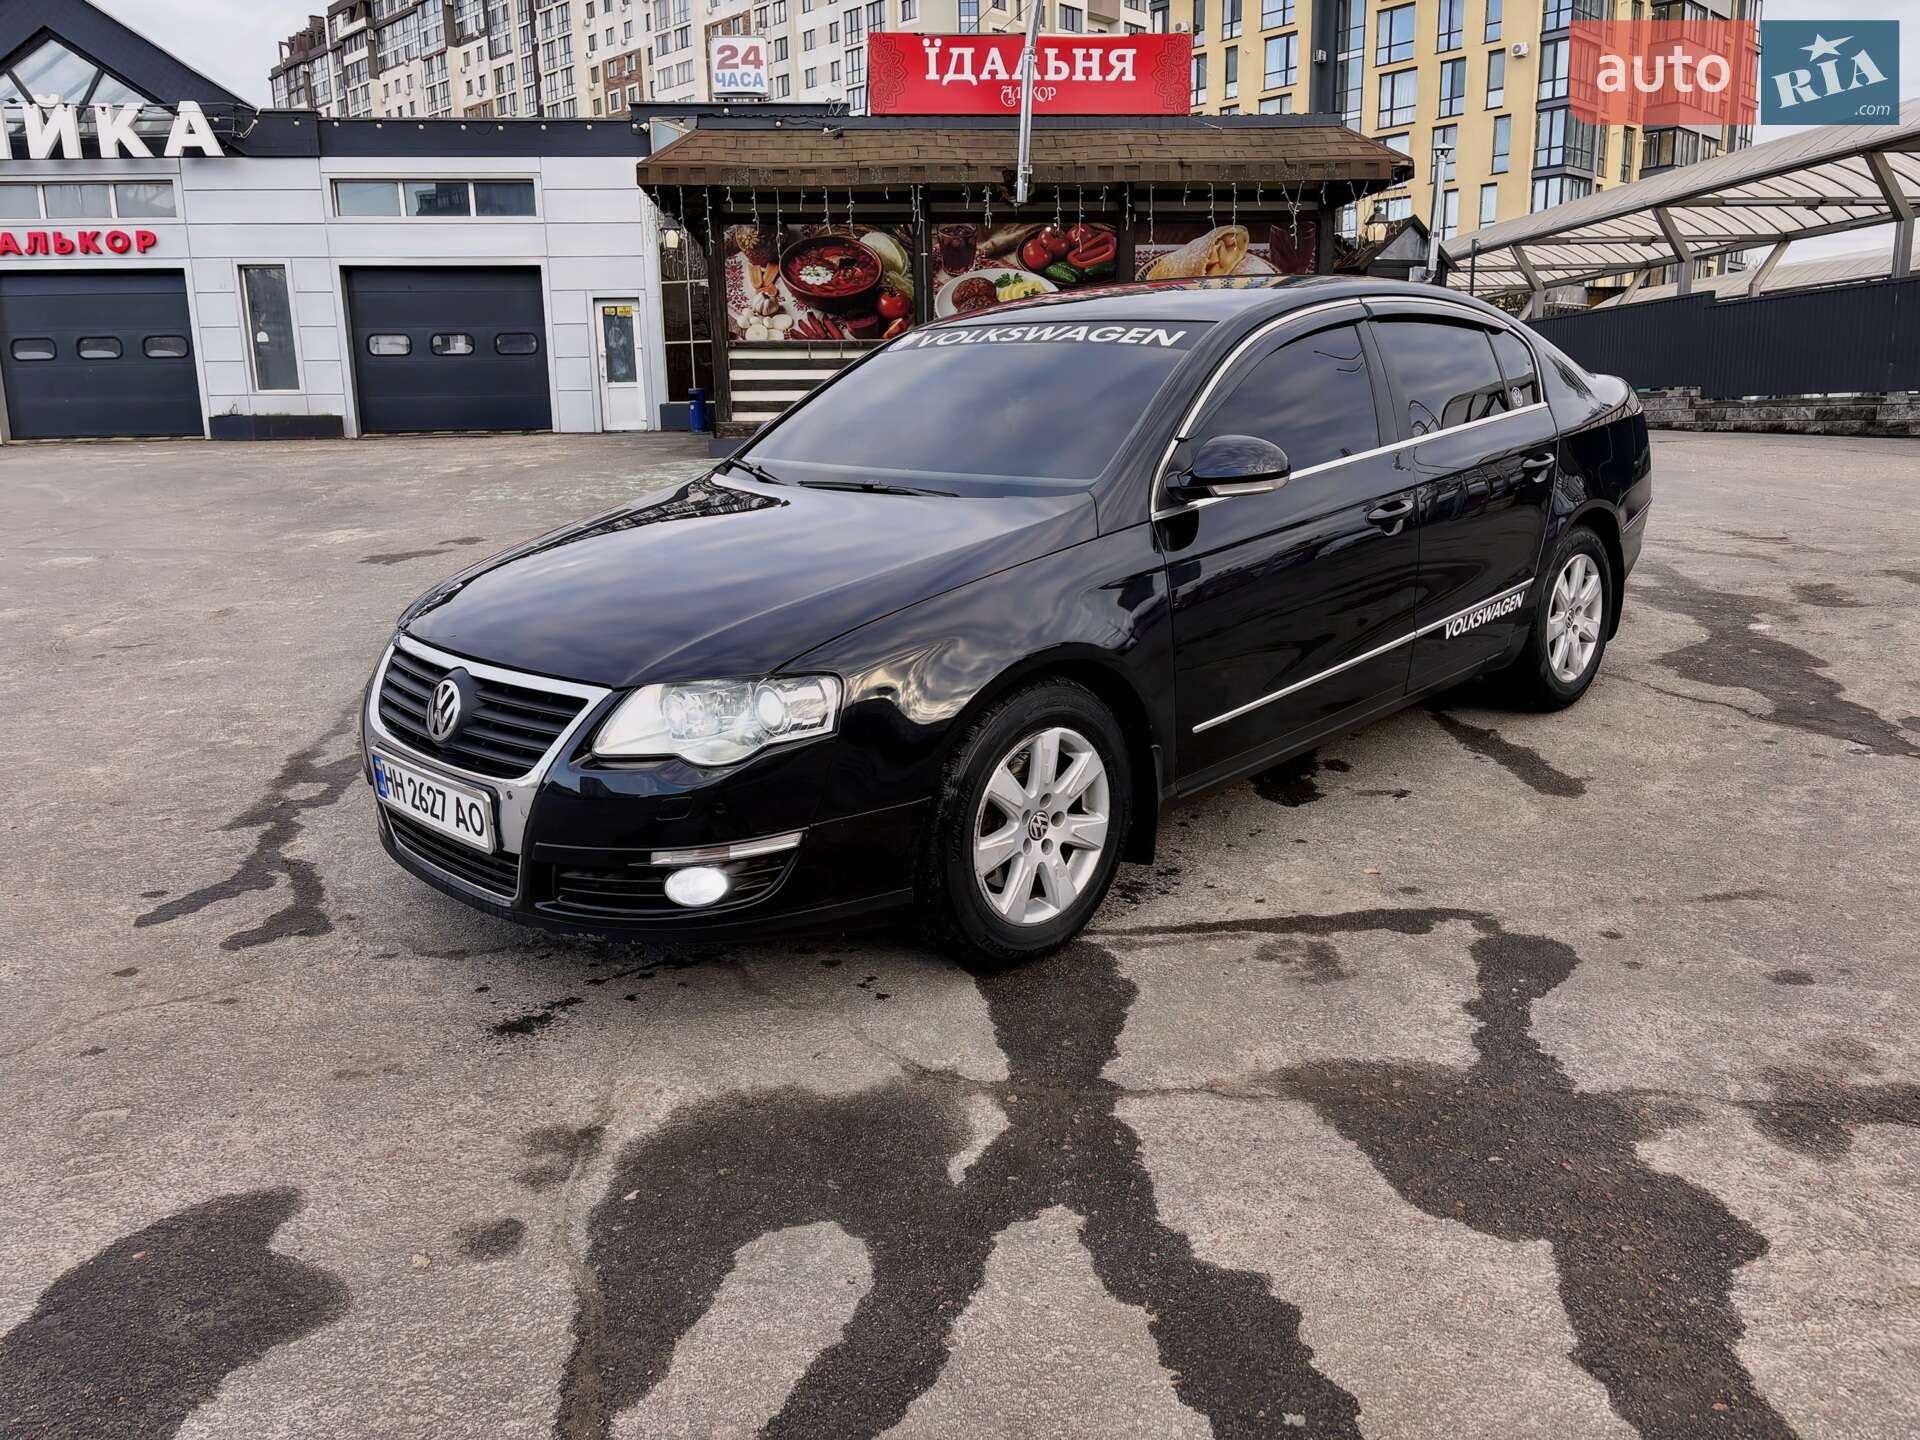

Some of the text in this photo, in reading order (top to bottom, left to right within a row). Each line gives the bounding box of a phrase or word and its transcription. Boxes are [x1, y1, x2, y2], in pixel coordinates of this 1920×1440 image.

[716, 44, 764, 70] 24
[715, 72, 765, 88] ЧАСА
[0, 230, 157, 256] АЛЬКОР
[918, 325, 1187, 348] VOLKSWAGEN
[1445, 590, 1525, 640] VOLKSWAGEN
[382, 763, 485, 837] HH 2627 AO
